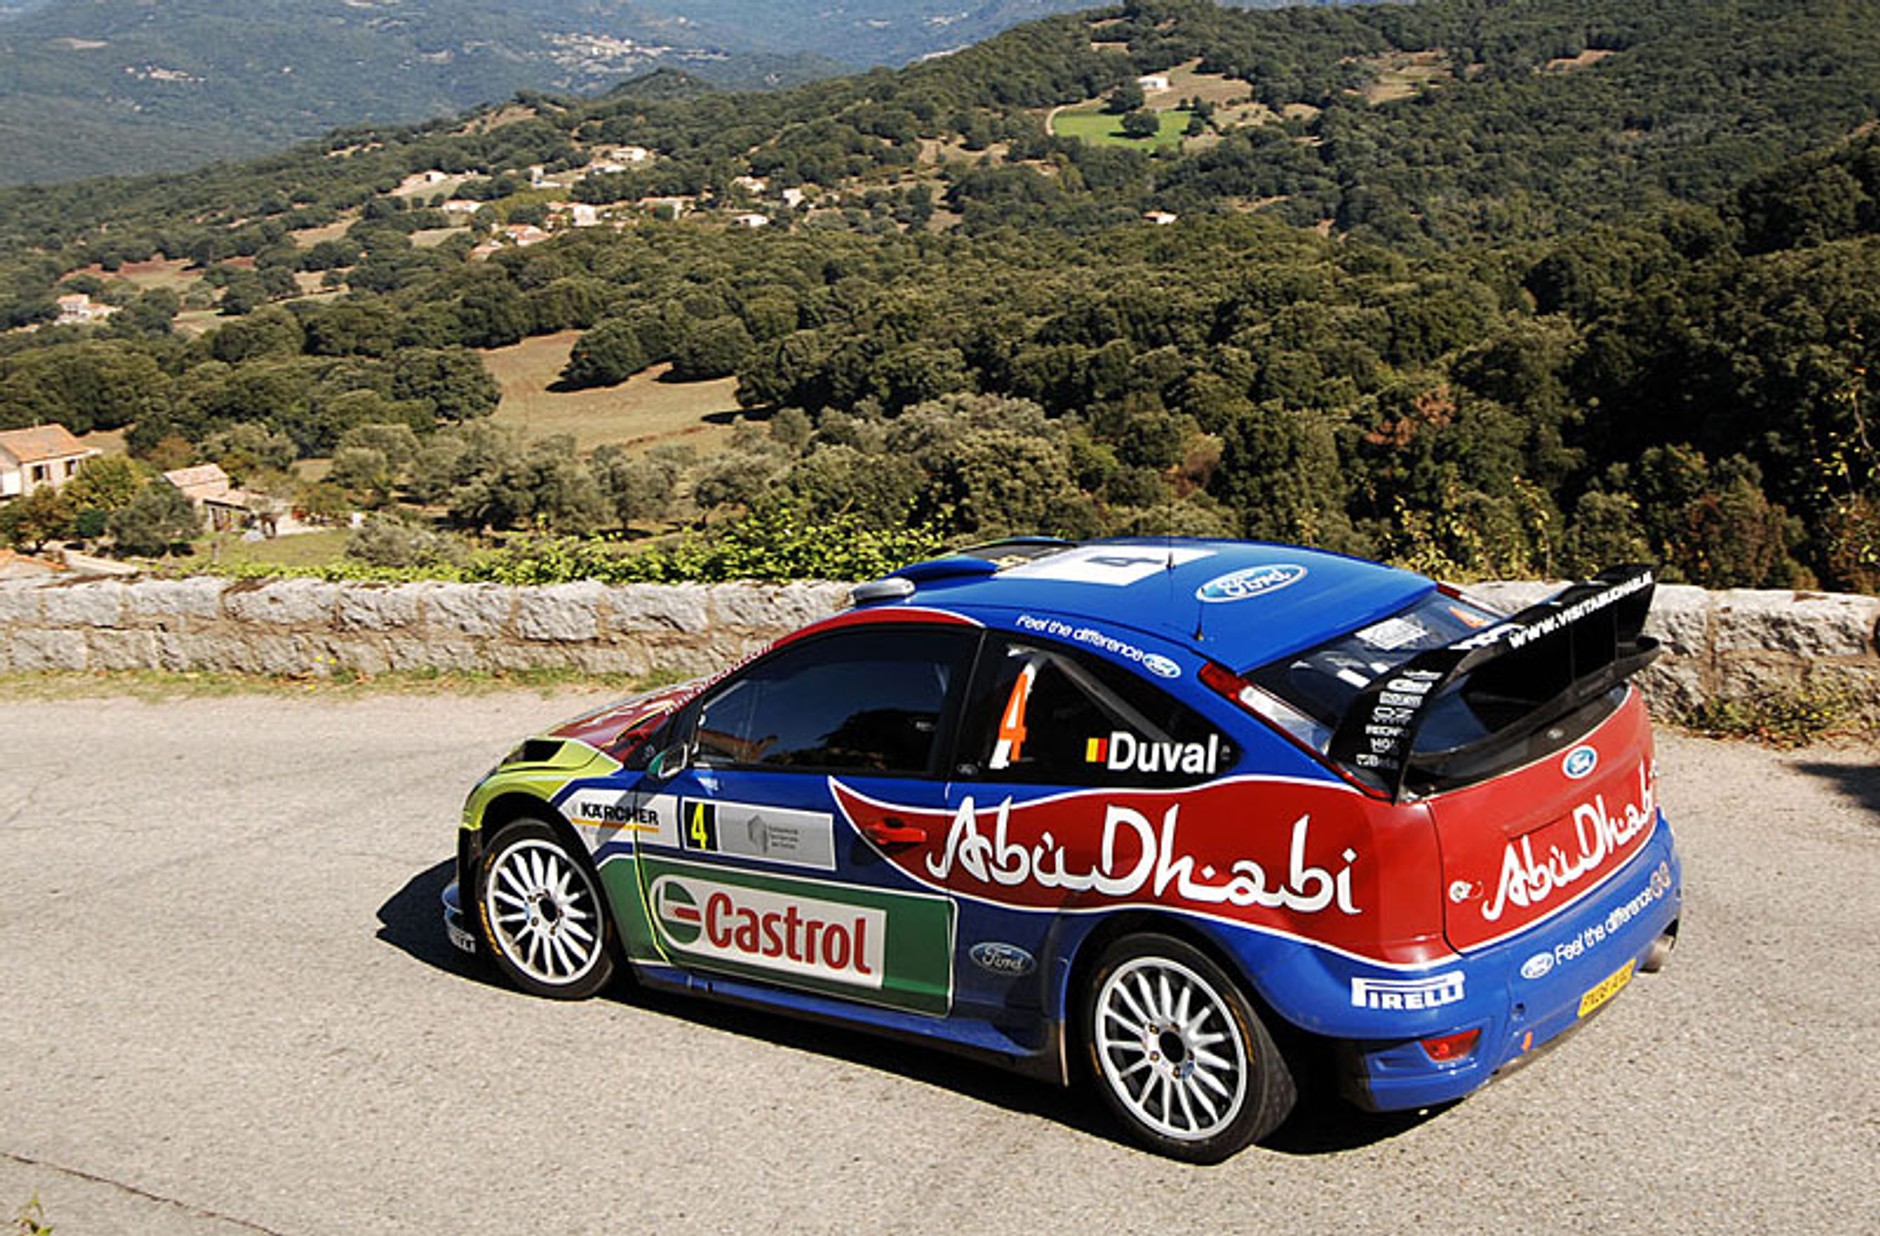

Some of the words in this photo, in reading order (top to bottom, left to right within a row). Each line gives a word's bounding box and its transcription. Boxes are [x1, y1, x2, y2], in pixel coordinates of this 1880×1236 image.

[1084, 556, 1165, 568] 4
[1216, 566, 1296, 598] Ford
[1015, 614, 1049, 631] Feel
[1049, 619, 1073, 638] the
[1073, 627, 1144, 662] difference
[1107, 731, 1219, 774] Duval
[690, 802, 707, 851] 4
[705, 892, 872, 976] Castrol
[1554, 933, 1585, 965] Feel
[1584, 924, 1606, 947] the
[981, 946, 1026, 970] Ford
[1351, 970, 1465, 1010] PIRELLI
